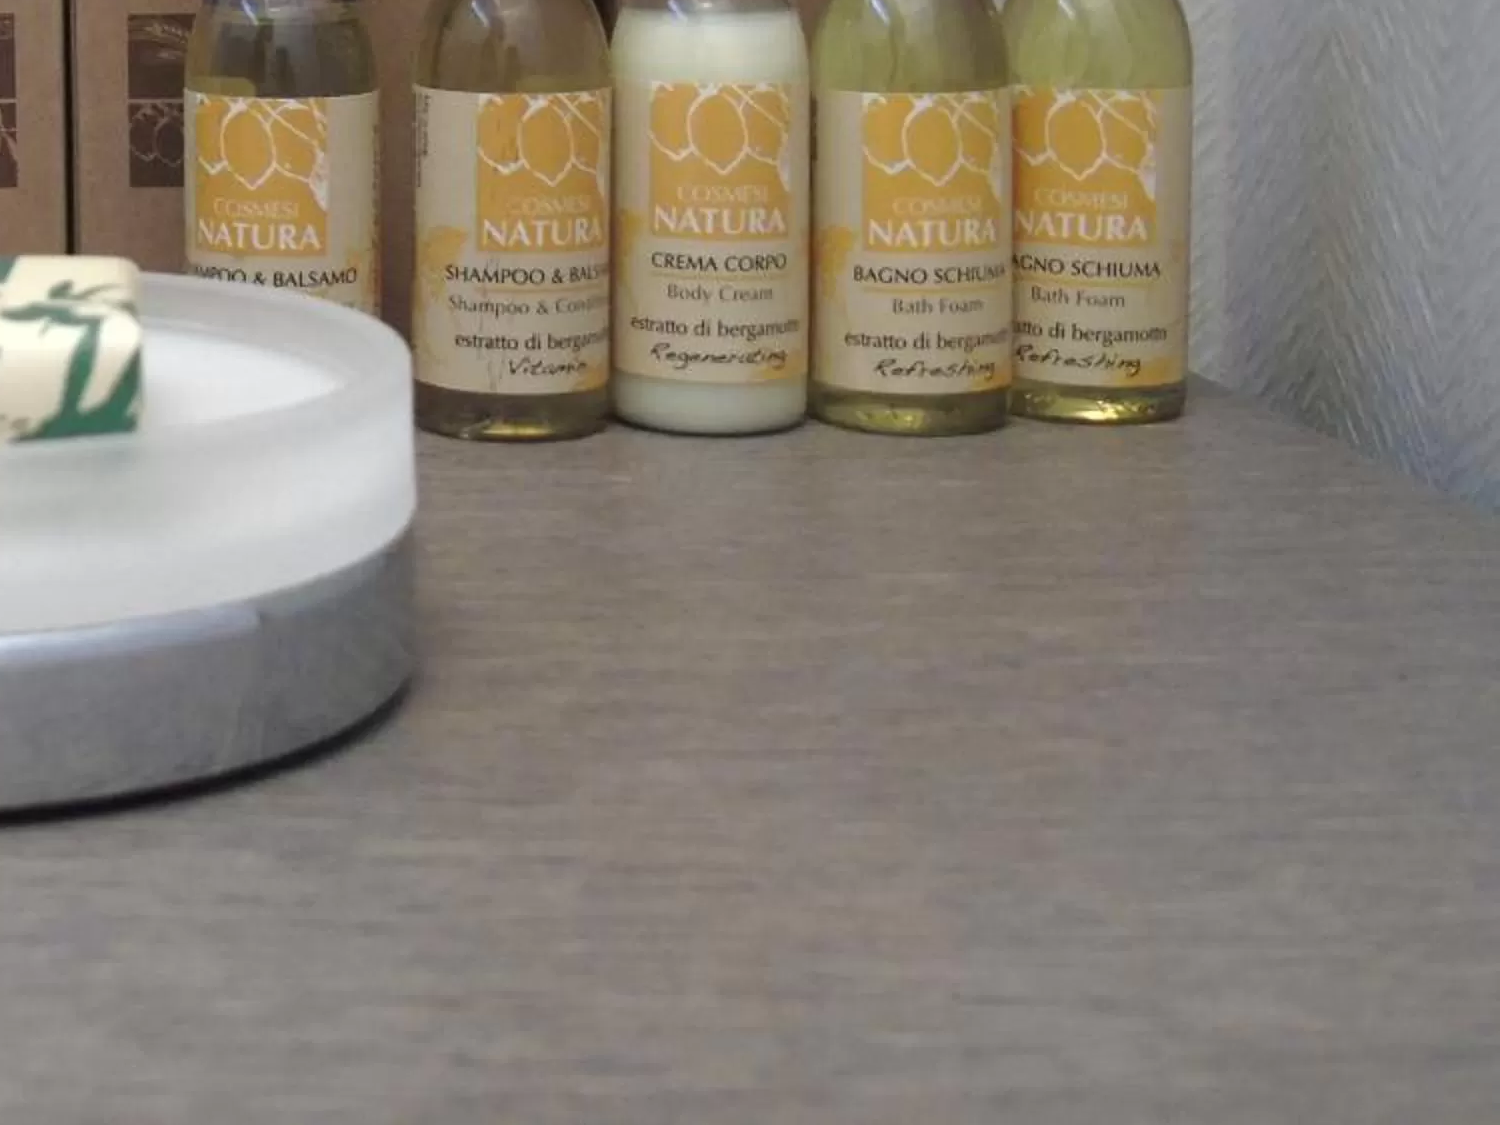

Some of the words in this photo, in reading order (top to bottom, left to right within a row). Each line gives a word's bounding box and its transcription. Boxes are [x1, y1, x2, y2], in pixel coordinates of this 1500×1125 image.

[654, 203, 788, 235] NATURA
[1014, 210, 1149, 241] NATURA
[199, 218, 322, 251] NATURA
[482, 218, 603, 248] NATURA
[867, 218, 998, 249] NATURA
[444, 262, 547, 287] SHAMPOO
[551, 266, 564, 285] &
[650, 251, 719, 273] CREMA
[723, 251, 788, 274] CORPO
[853, 264, 929, 285] BAGNO
[1012, 253, 1066, 275] AGNO
[1070, 259, 1162, 279] SCHIUMA
[272, 266, 359, 289] BALSAMO
[666, 282, 711, 305] Body
[1030, 285, 1070, 306] Bath
[1075, 289, 1126, 309] Foam
[448, 294, 530, 321] Shampoo
[535, 299, 550, 316] &
[892, 297, 934, 316] Bath
[629, 315, 689, 336] estratto
[693, 318, 712, 337] di
[1047, 321, 1066, 340] di
[454, 332, 520, 351] estratto
[524, 331, 542, 351] di
[843, 331, 908, 351] estratto
[912, 330, 931, 351] di
[1014, 343, 1142, 378] Refreshing
